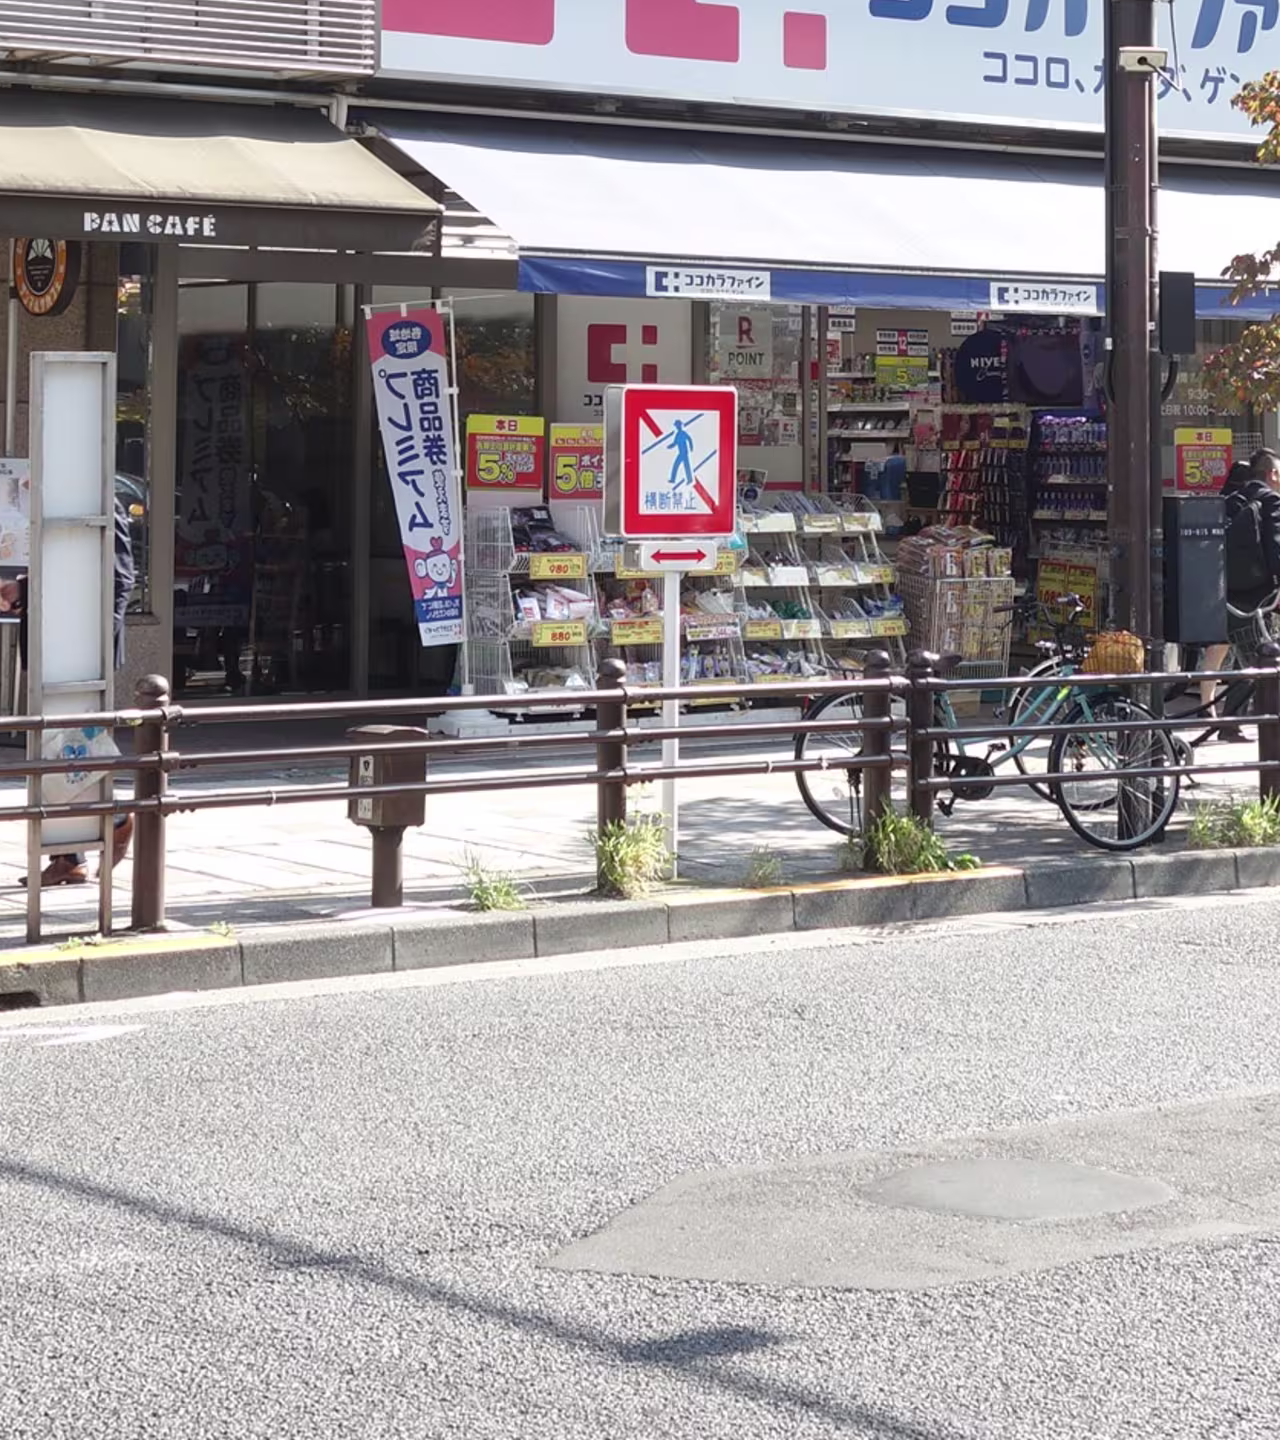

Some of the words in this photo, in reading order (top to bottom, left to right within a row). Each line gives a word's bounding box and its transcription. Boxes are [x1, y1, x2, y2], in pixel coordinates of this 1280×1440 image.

[83, 211, 141, 233] PAN
[684, 273, 765, 289] ココカラファイン
[1022, 288, 1091, 302] ココカラファイン
[728, 352, 765, 366] POINT
[970, 357, 1003, 368] NIVE
[495, 418, 518, 432] 本日
[477, 451, 516, 483] 5%
[645, 491, 697, 511] 横断禁止
[549, 563, 569, 574] 980
[551, 631, 571, 641] 880
